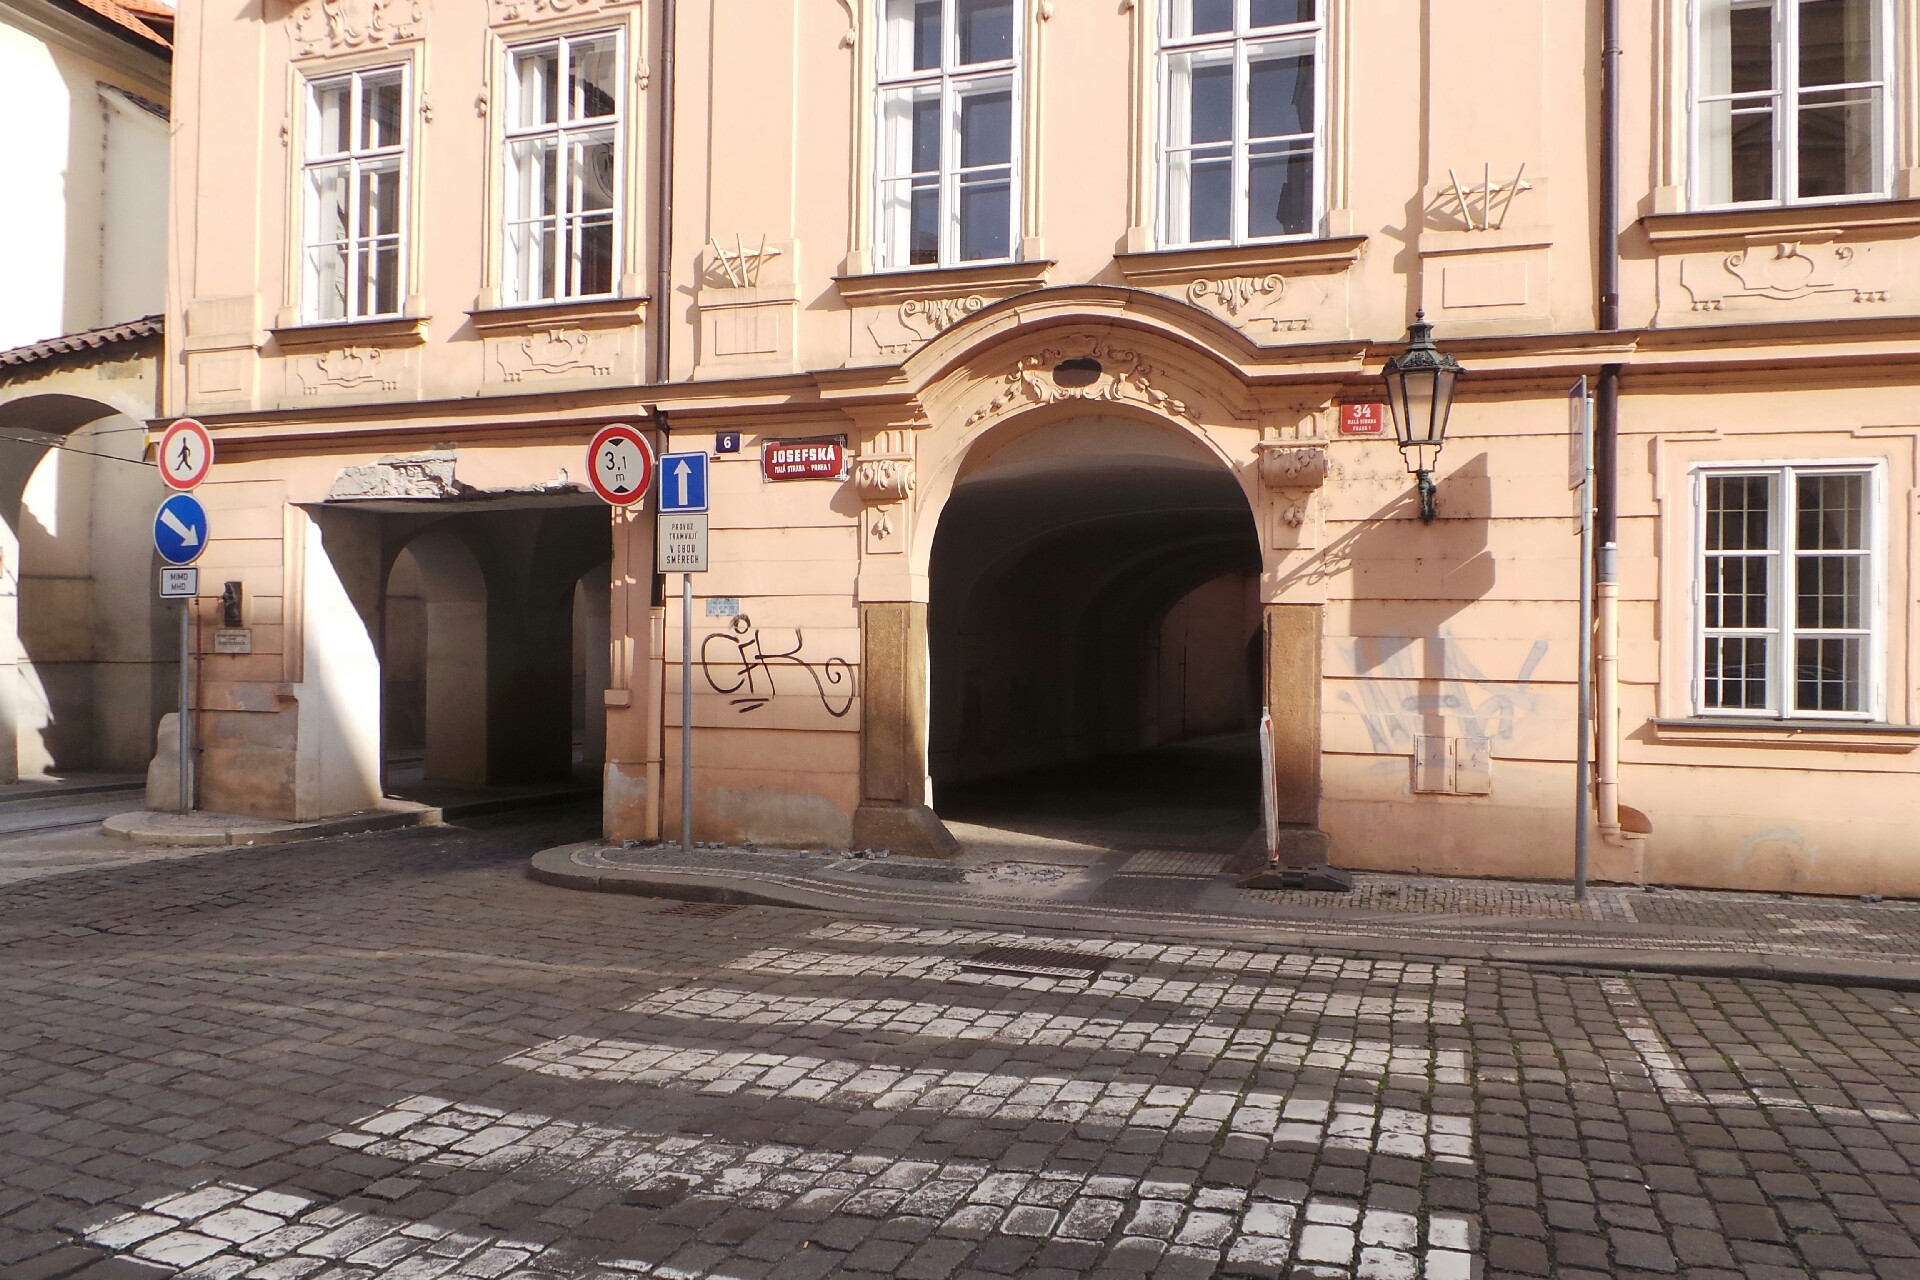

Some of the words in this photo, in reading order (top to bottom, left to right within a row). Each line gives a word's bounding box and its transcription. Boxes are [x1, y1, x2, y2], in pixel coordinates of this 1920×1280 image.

[1353, 404, 1371, 418] 34
[723, 436, 732, 449] 6
[772, 445, 835, 464] JOSEFSKÁ
[774, 464, 786, 473] MALÁ
[787, 464, 805, 473] STRANA
[811, 463, 827, 472] PRAHA
[615, 473, 625, 482] m
[671, 523, 694, 531] PROVOZ
[669, 531, 698, 540] TRAMVAJÍ
[670, 544, 674, 554] V
[677, 544, 696, 554] OBOU
[666, 554, 699, 564] SMĚRECH
[171, 582, 186, 591] MHD
